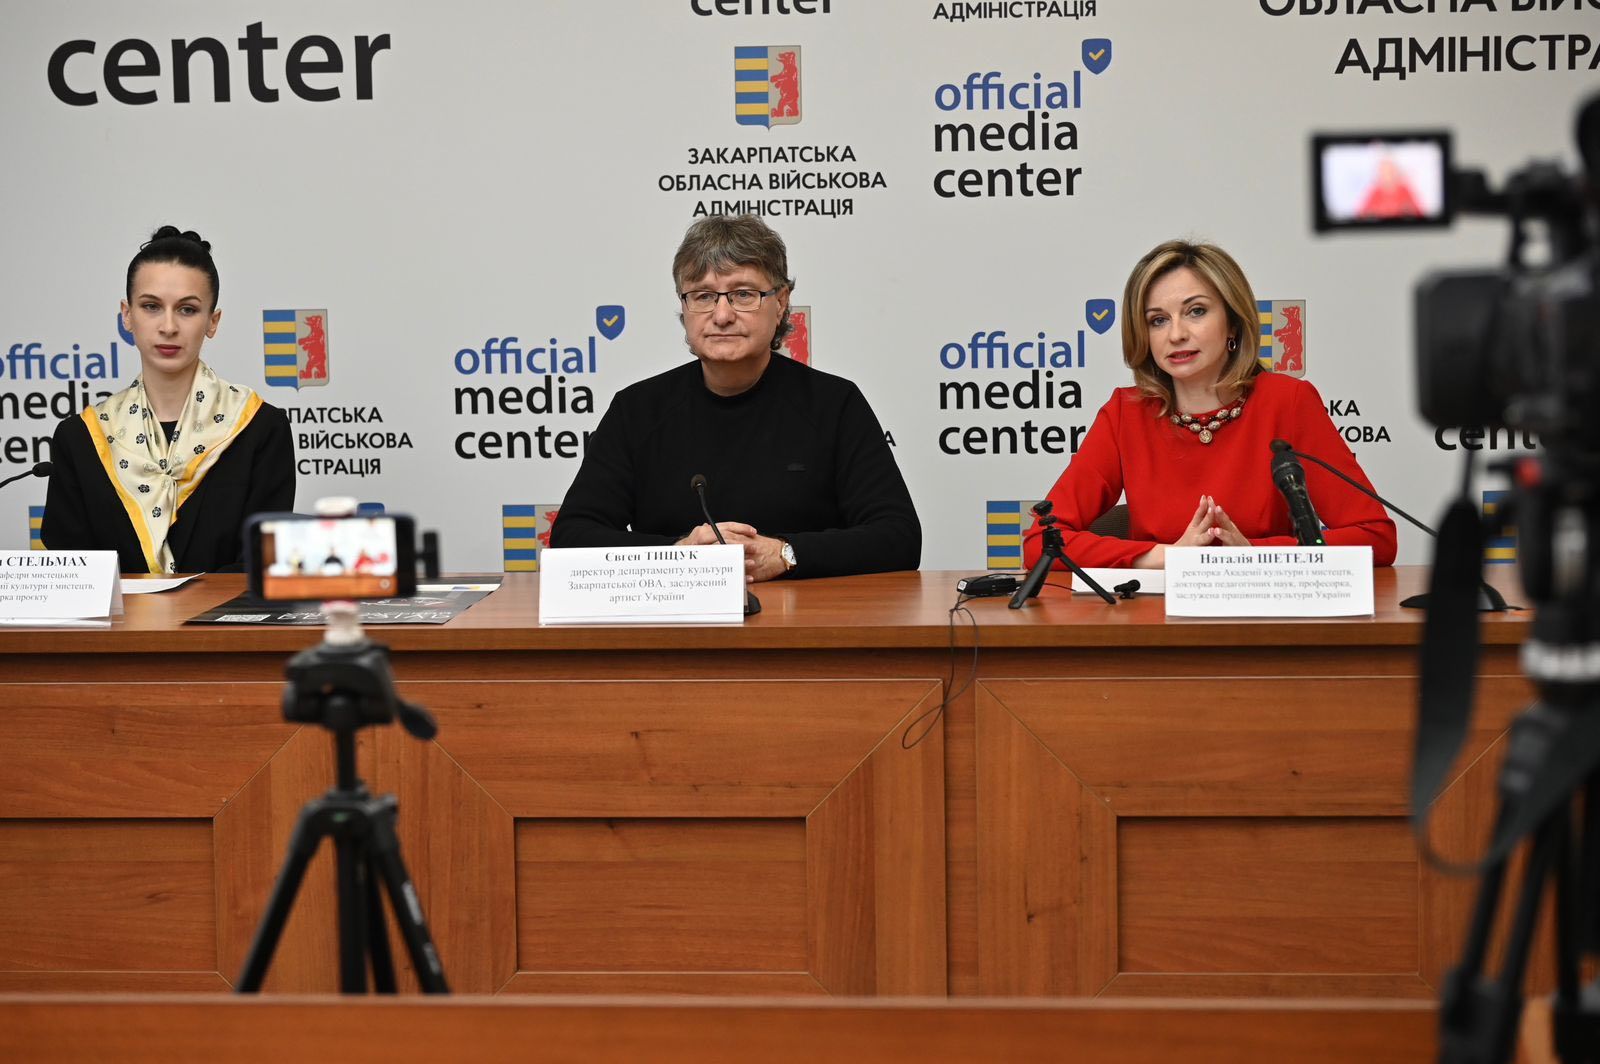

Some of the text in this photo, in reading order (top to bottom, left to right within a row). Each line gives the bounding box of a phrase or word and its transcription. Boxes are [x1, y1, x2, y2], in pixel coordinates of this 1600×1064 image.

[933, 0, 1097, 23] АДМІНІСТРАЦІЯ
[47, 21, 391, 106] center
[934, 70, 1081, 111] official
[934, 110, 1078, 152] media
[687, 145, 857, 165] ЗАКАРПАТСЬКА
[658, 170, 888, 191] ОБЛАСНА ВІЙСЬКОВА
[933, 162, 1082, 198] center
[692, 198, 854, 218] АДМІНІСТРАЦІЯ
[0, 342, 119, 379] fficial
[454, 336, 597, 375] official
[940, 330, 1085, 369] official
[454, 375, 594, 415] media
[939, 369, 1083, 410] media
[288, 407, 384, 424] ПАТСЬКА
[298, 430, 414, 450] ВІЙСЬКОВА
[938, 420, 1087, 455] center
[297, 458, 382, 478] СТРАЦІЯ
[6, 556, 88, 567] СТЕЛЬМАХ
[569, 568, 615, 578] директор
[687, 565, 734, 576] культури
[1200, 553, 1253, 564] Наталія
